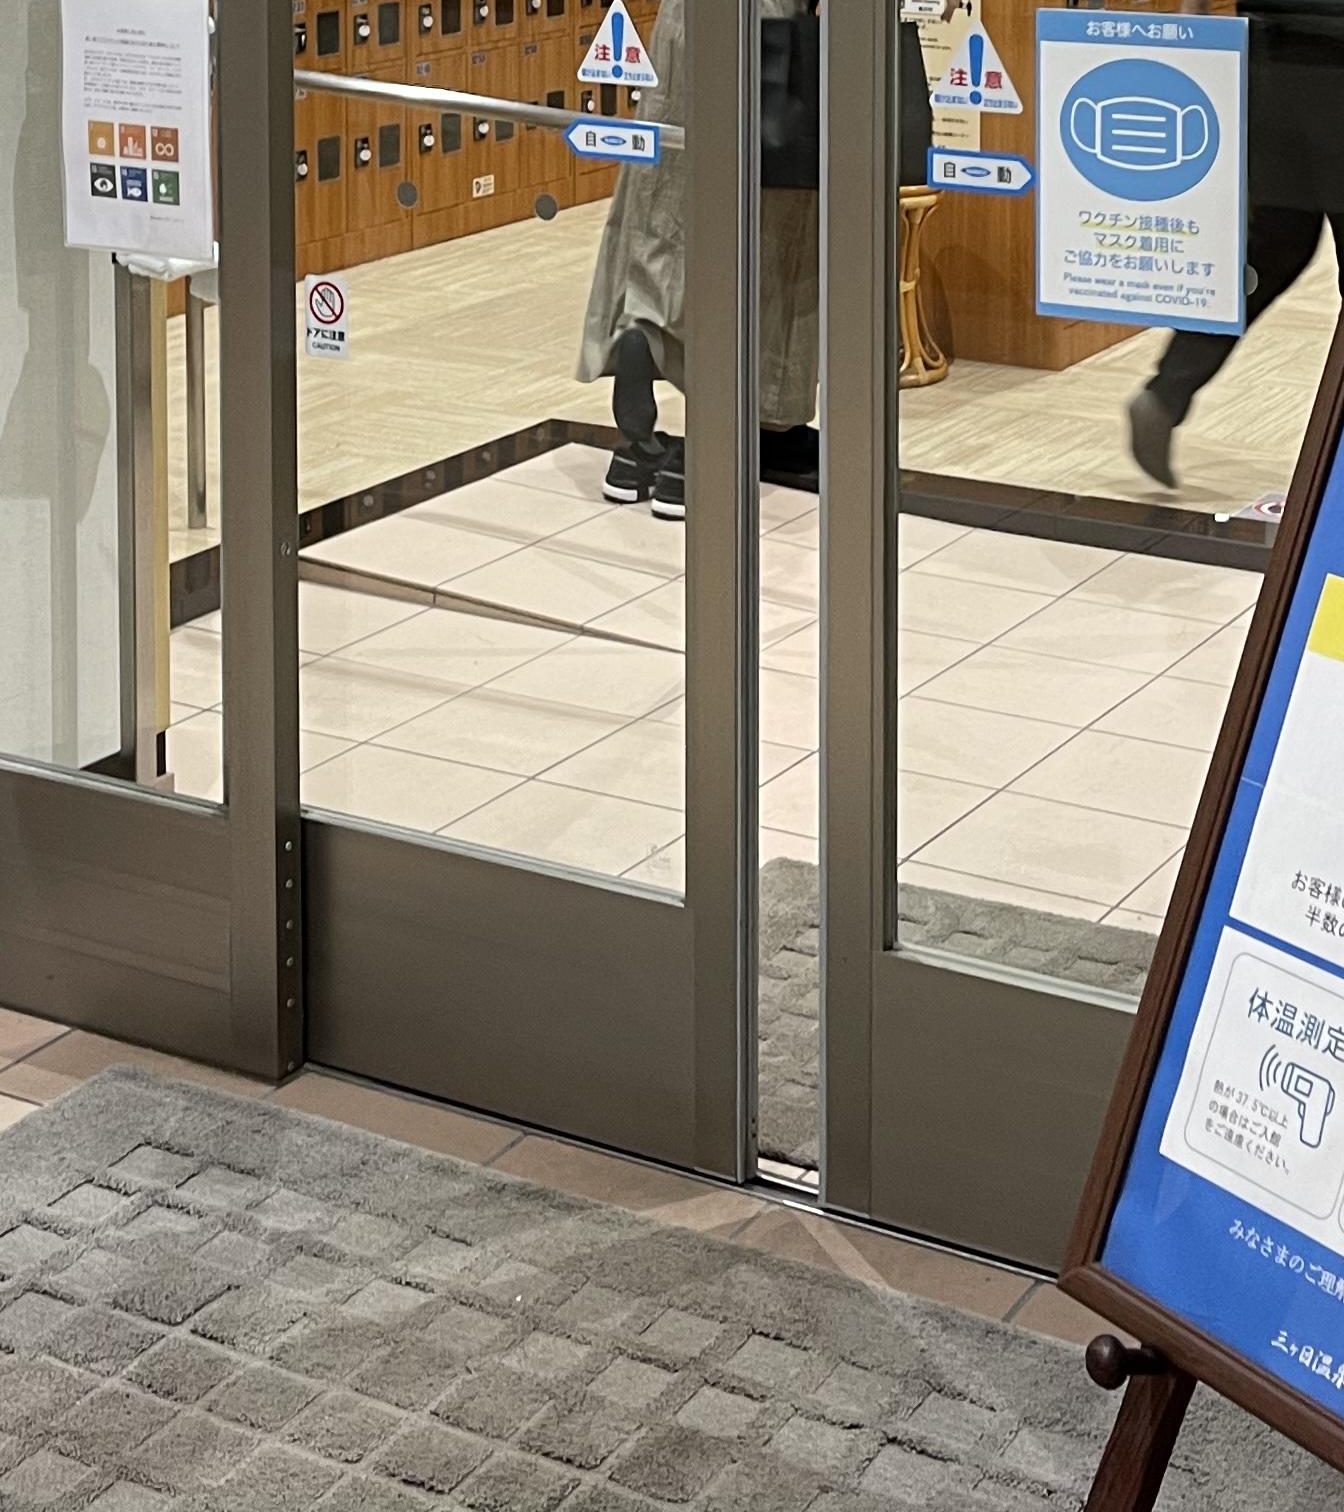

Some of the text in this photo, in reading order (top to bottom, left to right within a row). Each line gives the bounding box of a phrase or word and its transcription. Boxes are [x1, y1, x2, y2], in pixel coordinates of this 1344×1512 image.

[1086, 21, 1194, 40] お客様へお願い
[1078, 210, 1200, 235] ワクチン接種後も
[1093, 233, 1185, 254] マスク着用に
[1064, 250, 1215, 277] ご協力をお願いします
[1063, 272, 1092, 283] Please
[1069, 288, 1118, 299] vaccinated
[1120, 292, 1152, 302] against
[312, 342, 341, 352] CAUTION
